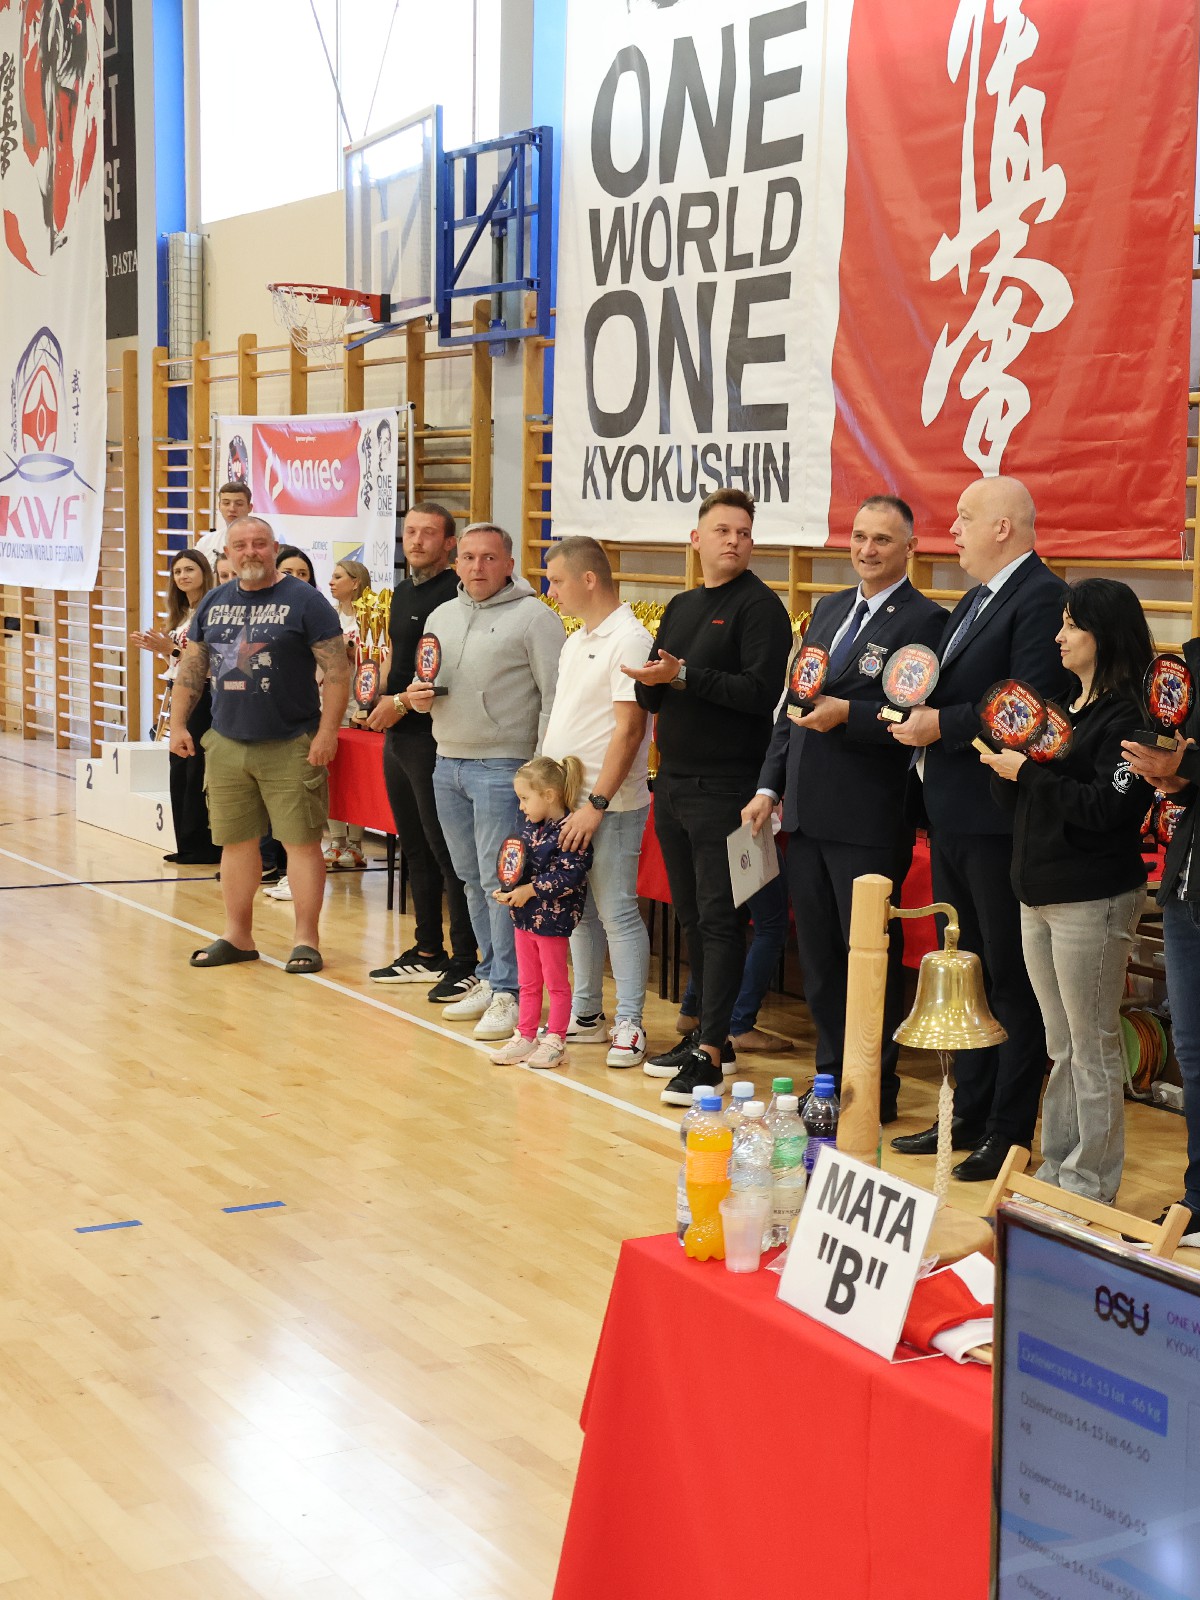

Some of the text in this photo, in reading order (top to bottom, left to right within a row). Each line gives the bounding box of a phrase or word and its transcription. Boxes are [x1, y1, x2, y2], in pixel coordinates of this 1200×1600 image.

[590, 5, 807, 198] ONE
[588, 176, 803, 286] WORLD
[584, 272, 792, 439] ONE
[581, 441, 791, 503] KYOKUSHIN
[0, 494, 80, 539] KWF
[207, 603, 291, 626] CIVIL WAR
[86, 763, 93, 789] 2
[112, 747, 119, 775] 1
[156, 803, 164, 832] 3
[816, 1161, 917, 1254] MATA
[1167, 1311, 1192, 1330] ONE
